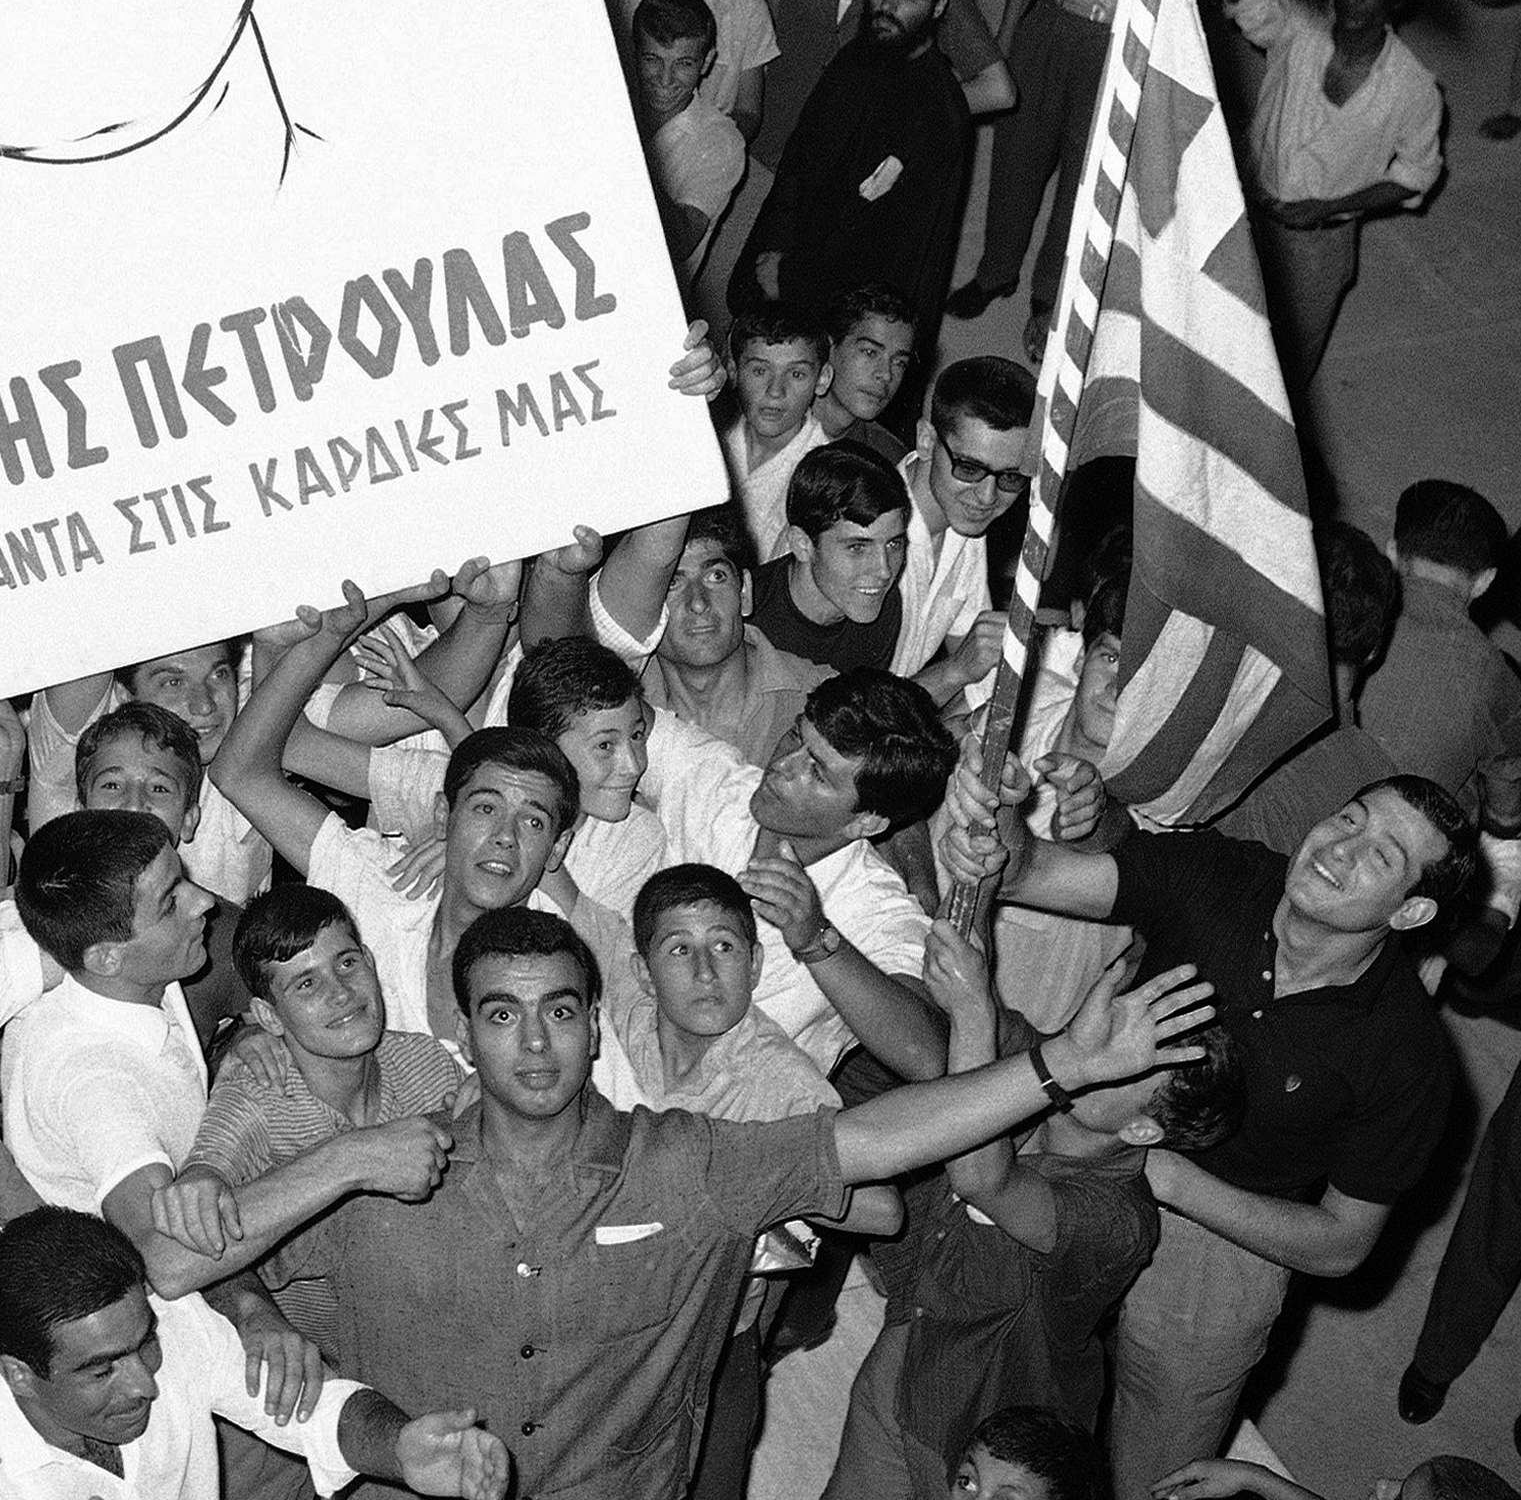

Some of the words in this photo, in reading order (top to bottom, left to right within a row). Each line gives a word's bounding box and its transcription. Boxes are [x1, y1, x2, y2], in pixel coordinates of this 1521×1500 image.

[112, 212, 617, 449] ΠΕΤΡΟΥΛΑΣ
[113, 475, 230, 554] ΣΤΙΣ
[249, 399, 481, 517] ΚΑΡΔΙΕΣ
[495, 360, 617, 447] ΜΑΣ
